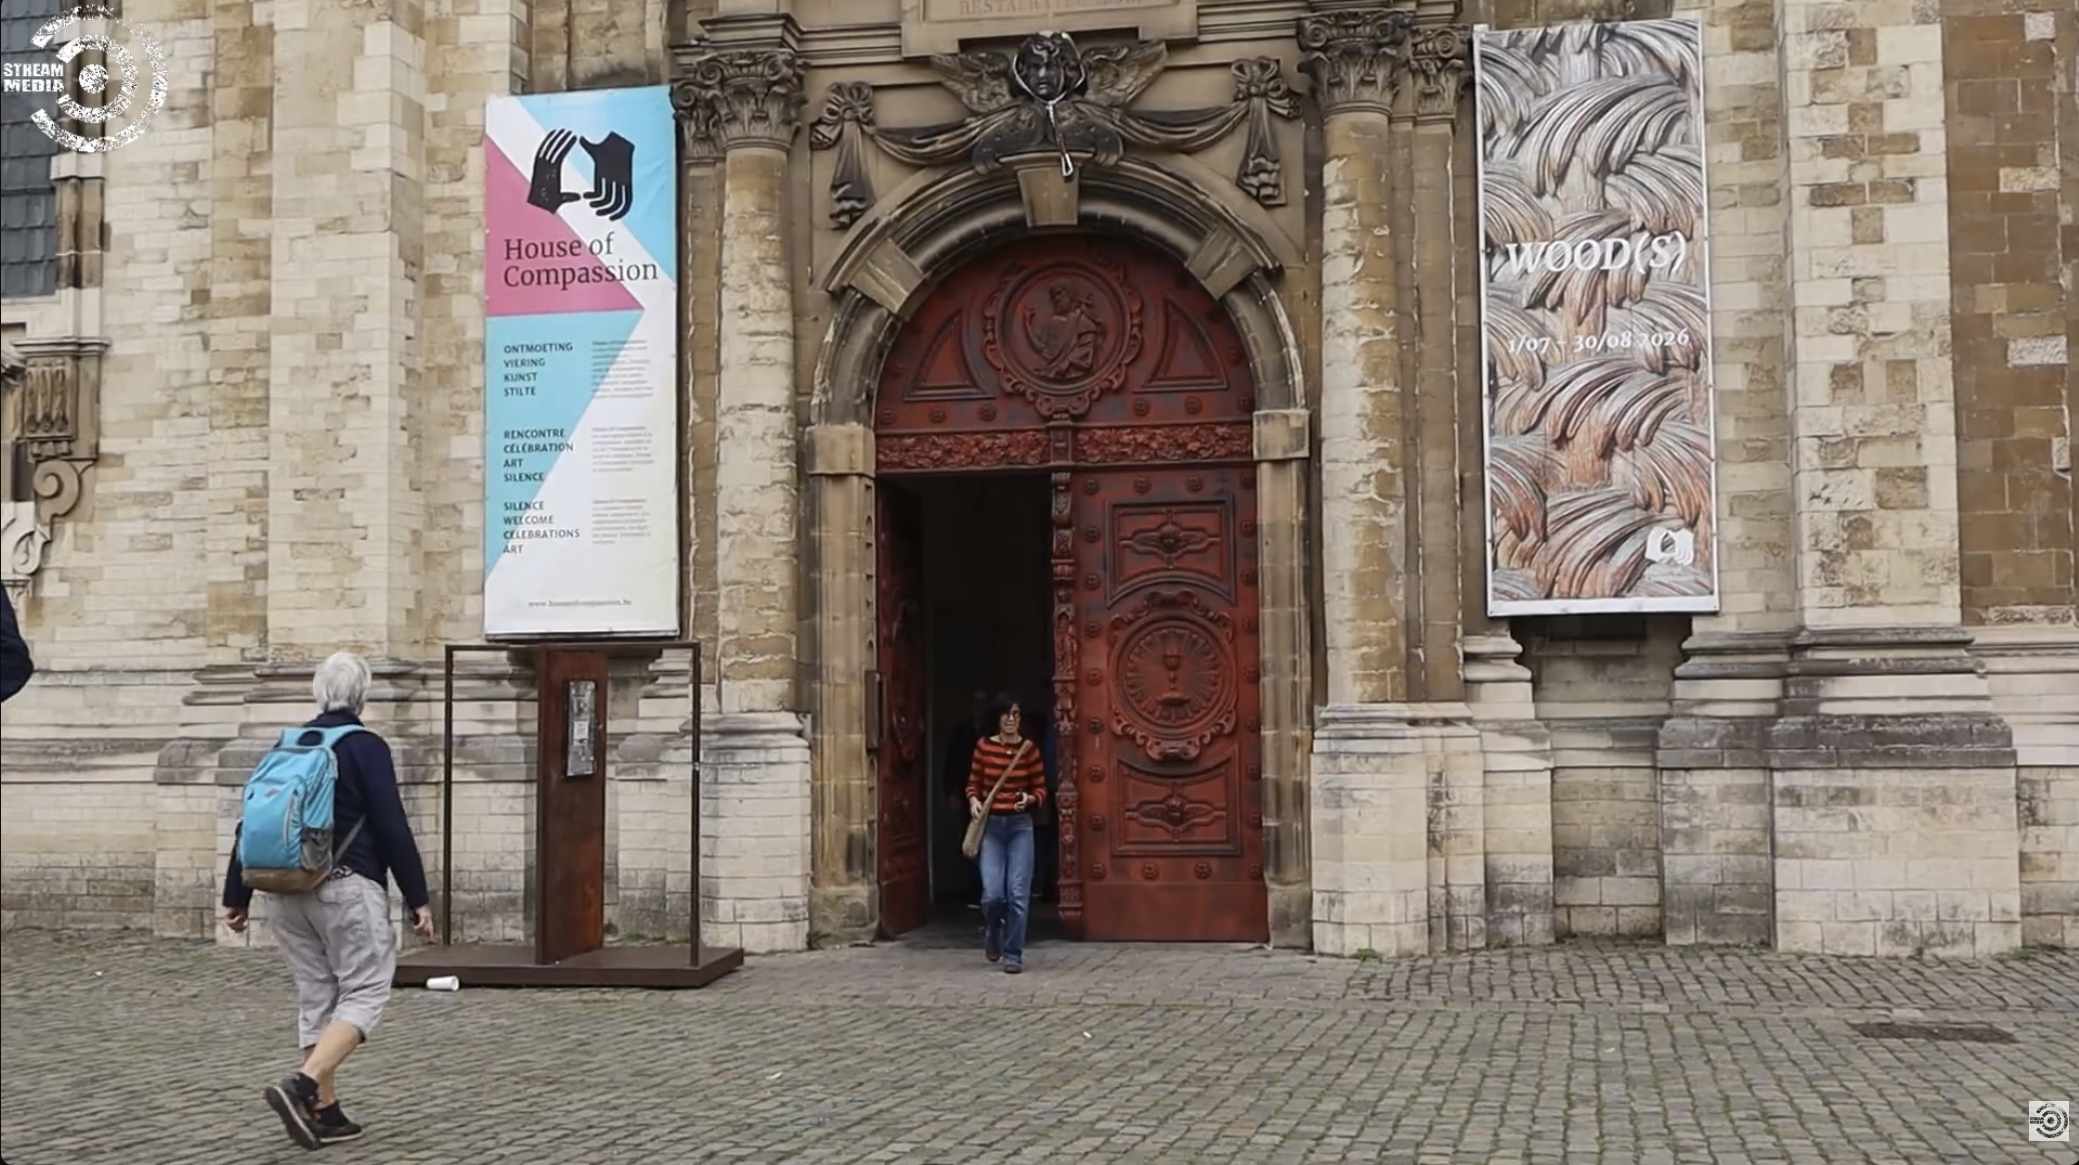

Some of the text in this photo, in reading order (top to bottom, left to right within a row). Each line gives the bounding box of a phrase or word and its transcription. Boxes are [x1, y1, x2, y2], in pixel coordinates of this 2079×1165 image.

[504, 231, 615, 261] House of
[1505, 230, 1687, 275] WOOD(S)
[503, 259, 658, 291] Compassion
[1573, 330, 1632, 351] 30/08
[1637, 326, 1690, 348] 2026
[503, 342, 573, 354] ONTMOETING
[503, 357, 546, 368] VIERING
[503, 372, 538, 382] KUNST
[503, 386, 536, 397] STILTE
[503, 428, 565, 439] RENCONTRE
[503, 458, 524, 468] ART
[503, 472, 545, 482] SILENCE
[503, 501, 545, 511] SILENCE
[503, 515, 554, 525] WELCOME
[503, 529, 580, 540] CELEBRATIONS
[503, 544, 523, 554] ART
